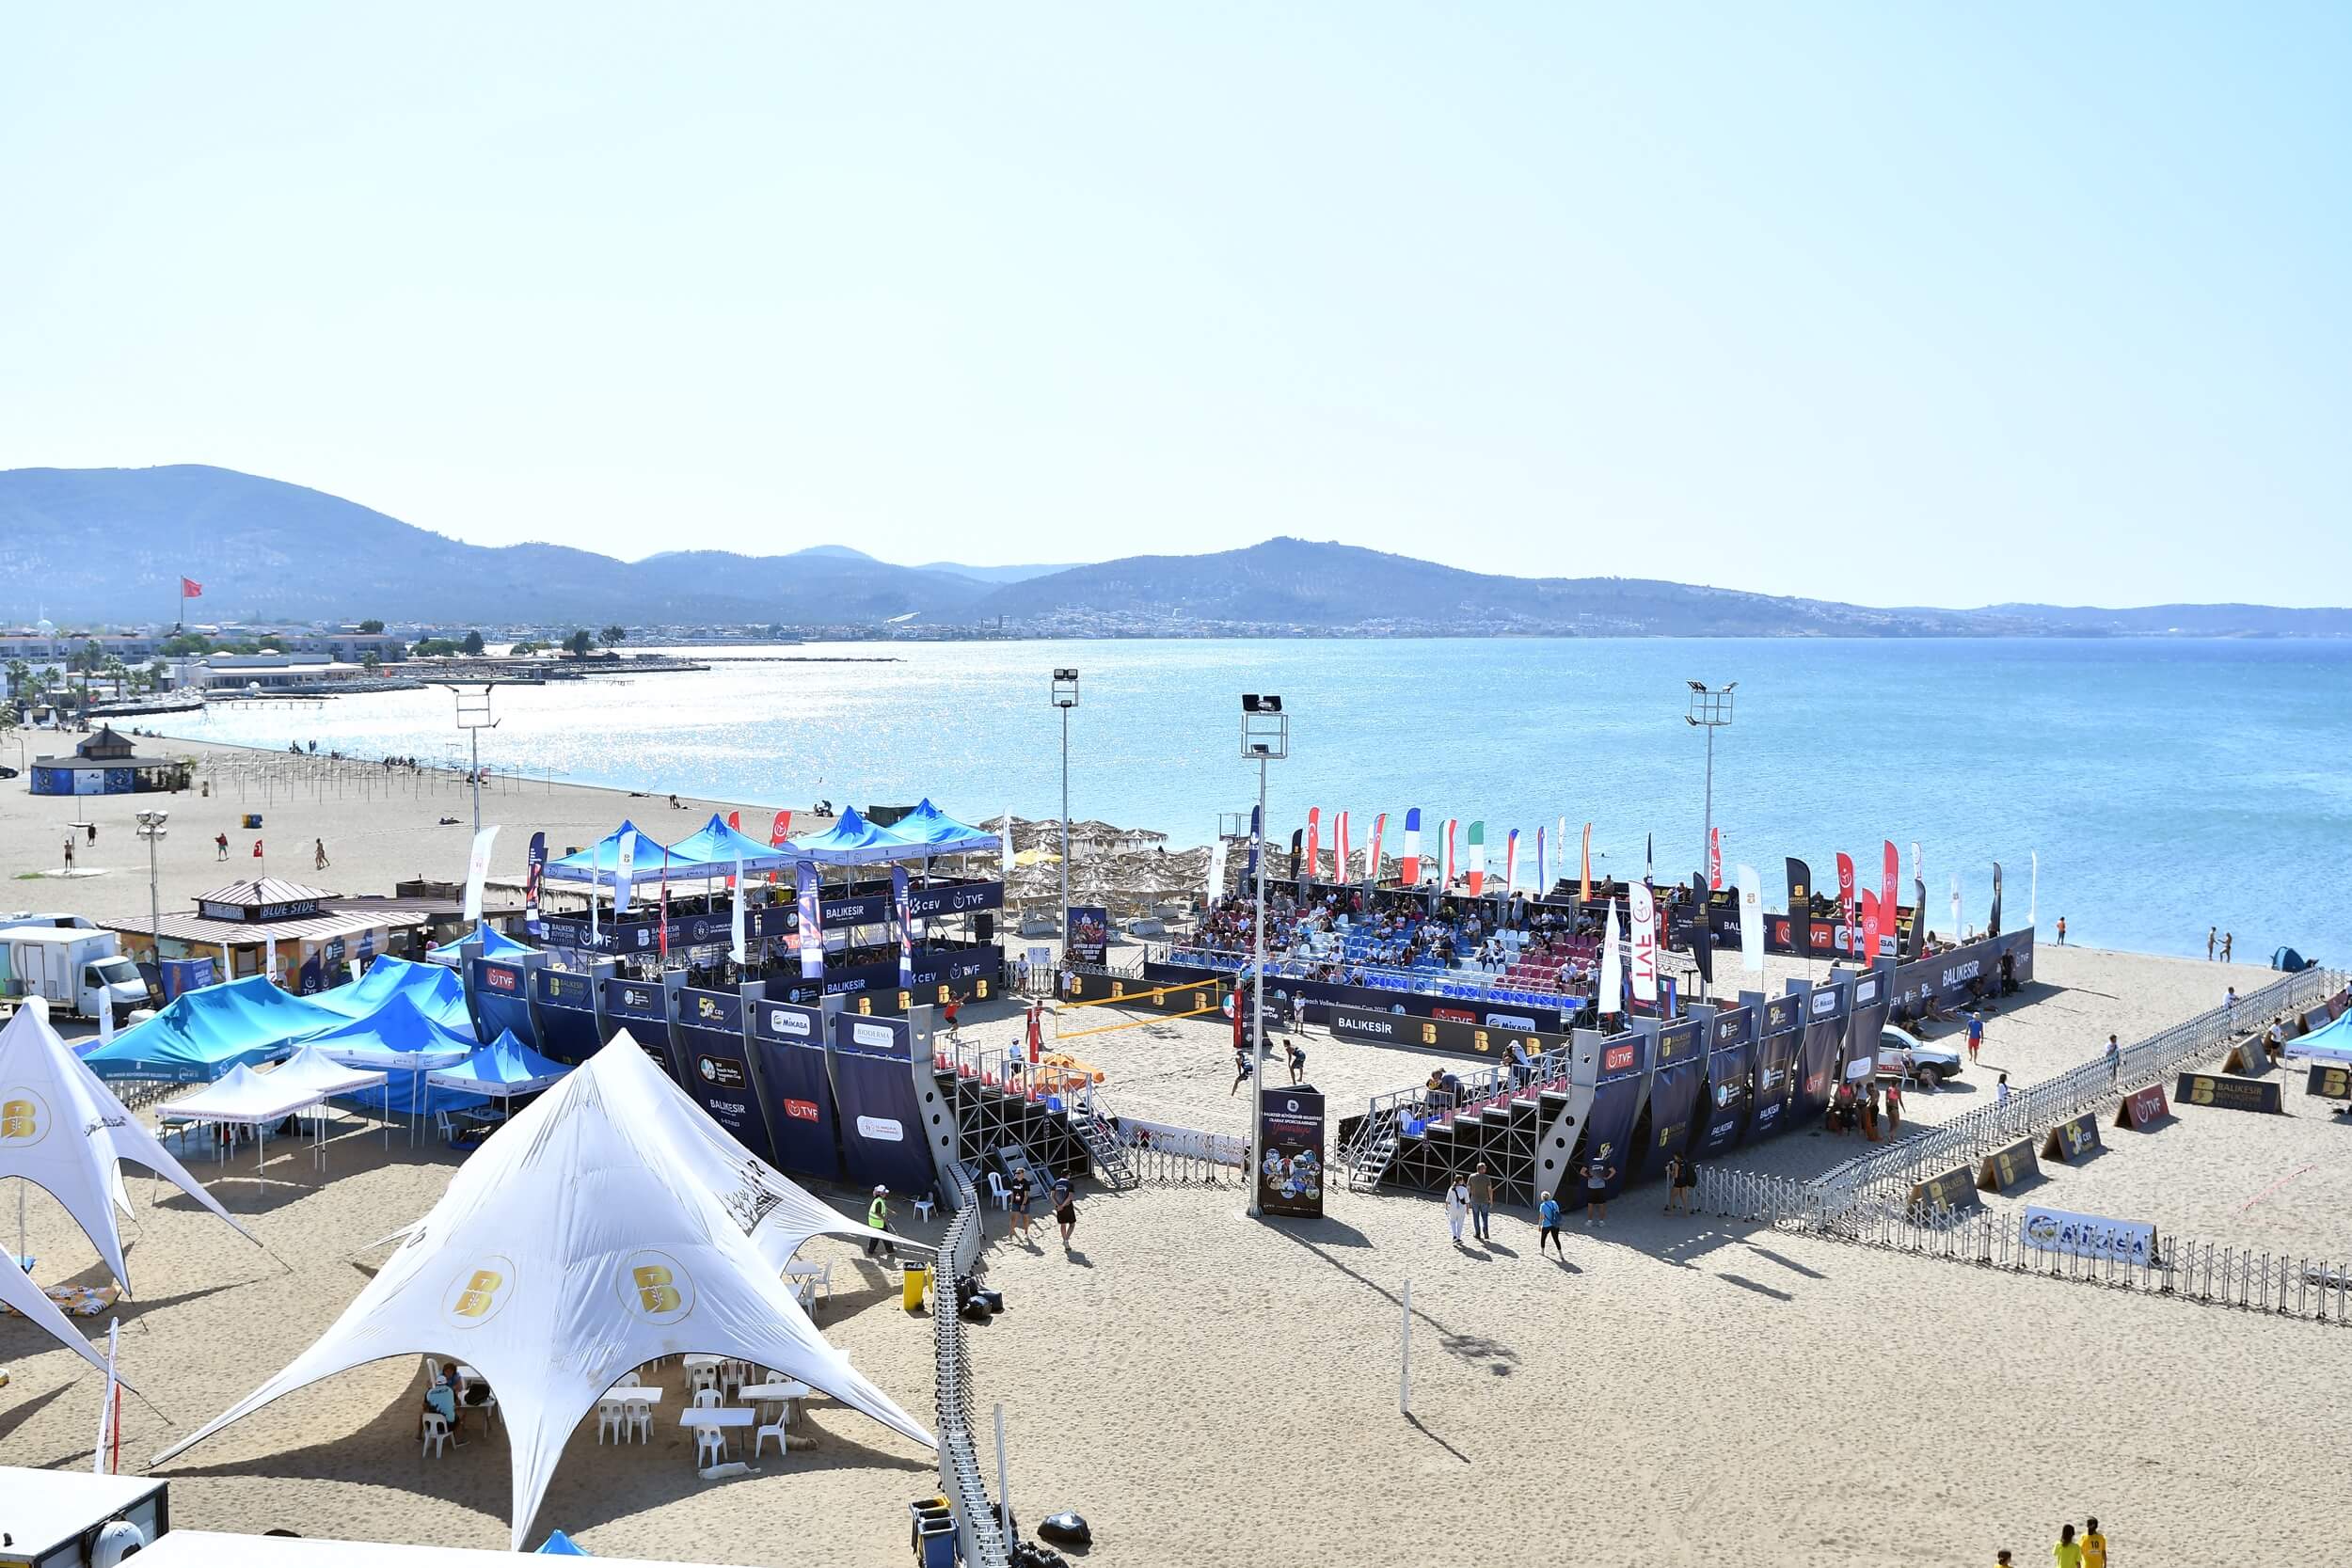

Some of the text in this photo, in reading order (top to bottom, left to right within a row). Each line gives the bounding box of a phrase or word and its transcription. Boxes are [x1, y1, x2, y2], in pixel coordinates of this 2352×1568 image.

[1711, 855, 1721, 881] TVF
[262, 901, 316, 918] BLUE SIDE
[825, 894, 984, 919] BALIKESİR CEV TVF
[551, 923, 576, 933] BALIKESİR
[1810, 930, 1828, 943] VF
[1854, 935, 1895, 948] MSA
[1942, 959, 1979, 987] BALIKESİR
[499, 975, 513, 986] TVF
[827, 978, 866, 994] BALIKESİR
[917, 972, 937, 984] CEV
[1338, 1017, 1392, 1035] BALIKESİR
[857, 1028, 890, 1040] BIODERMA
[1618, 1052, 1632, 1064] TVF
[709, 1099, 746, 1115] BALIKESİR
[801, 1106, 818, 1118] TVF
[2146, 1097, 2161, 1116] TVF
[2082, 1132, 2092, 1142] CEV
